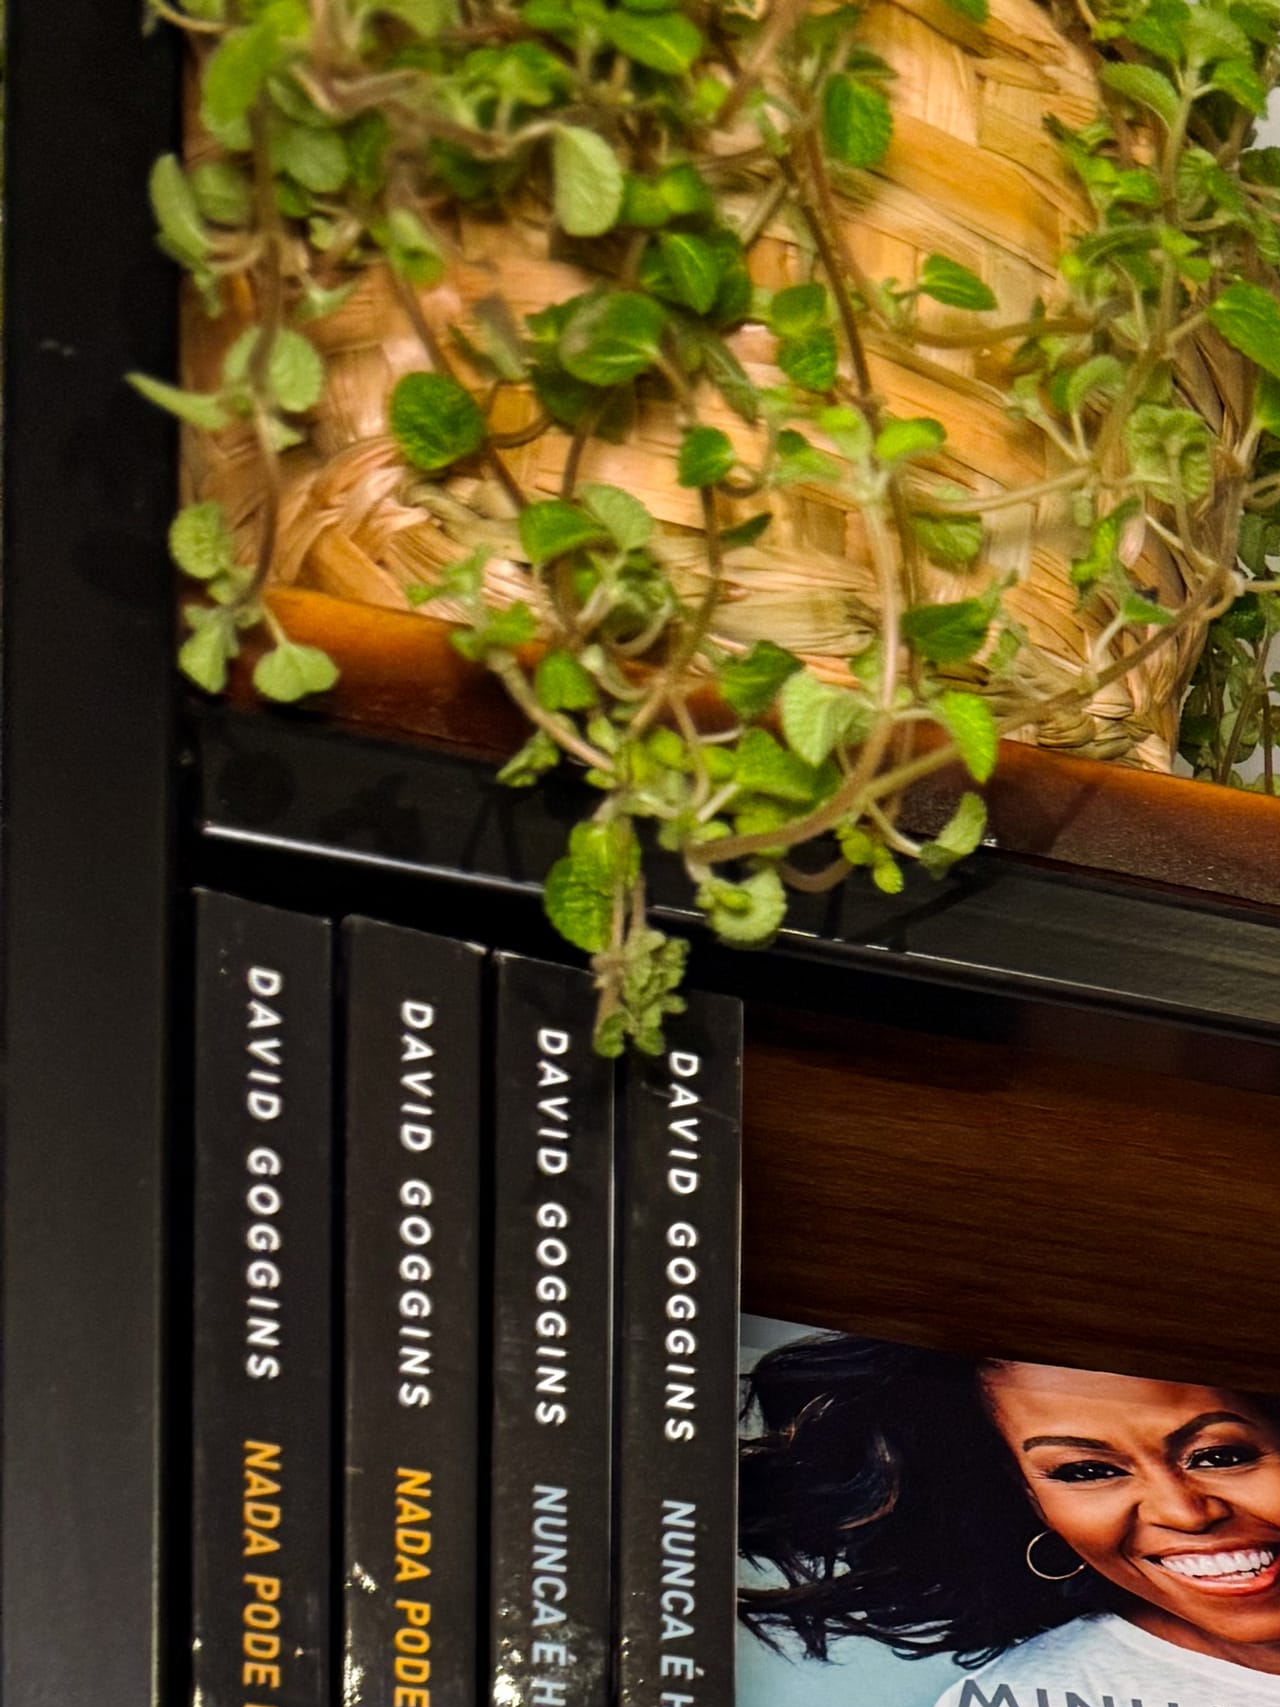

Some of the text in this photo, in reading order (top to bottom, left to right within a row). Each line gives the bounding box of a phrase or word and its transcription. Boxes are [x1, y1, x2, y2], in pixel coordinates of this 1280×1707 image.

[246, 967, 281, 1377] DAVID GOGGINS
[243, 1440, 280, 1555] NADA
[532, 1485, 572, 1638] NUNCA
[242, 1573, 280, 1688] PODE
[532, 1641, 576, 1670] É
